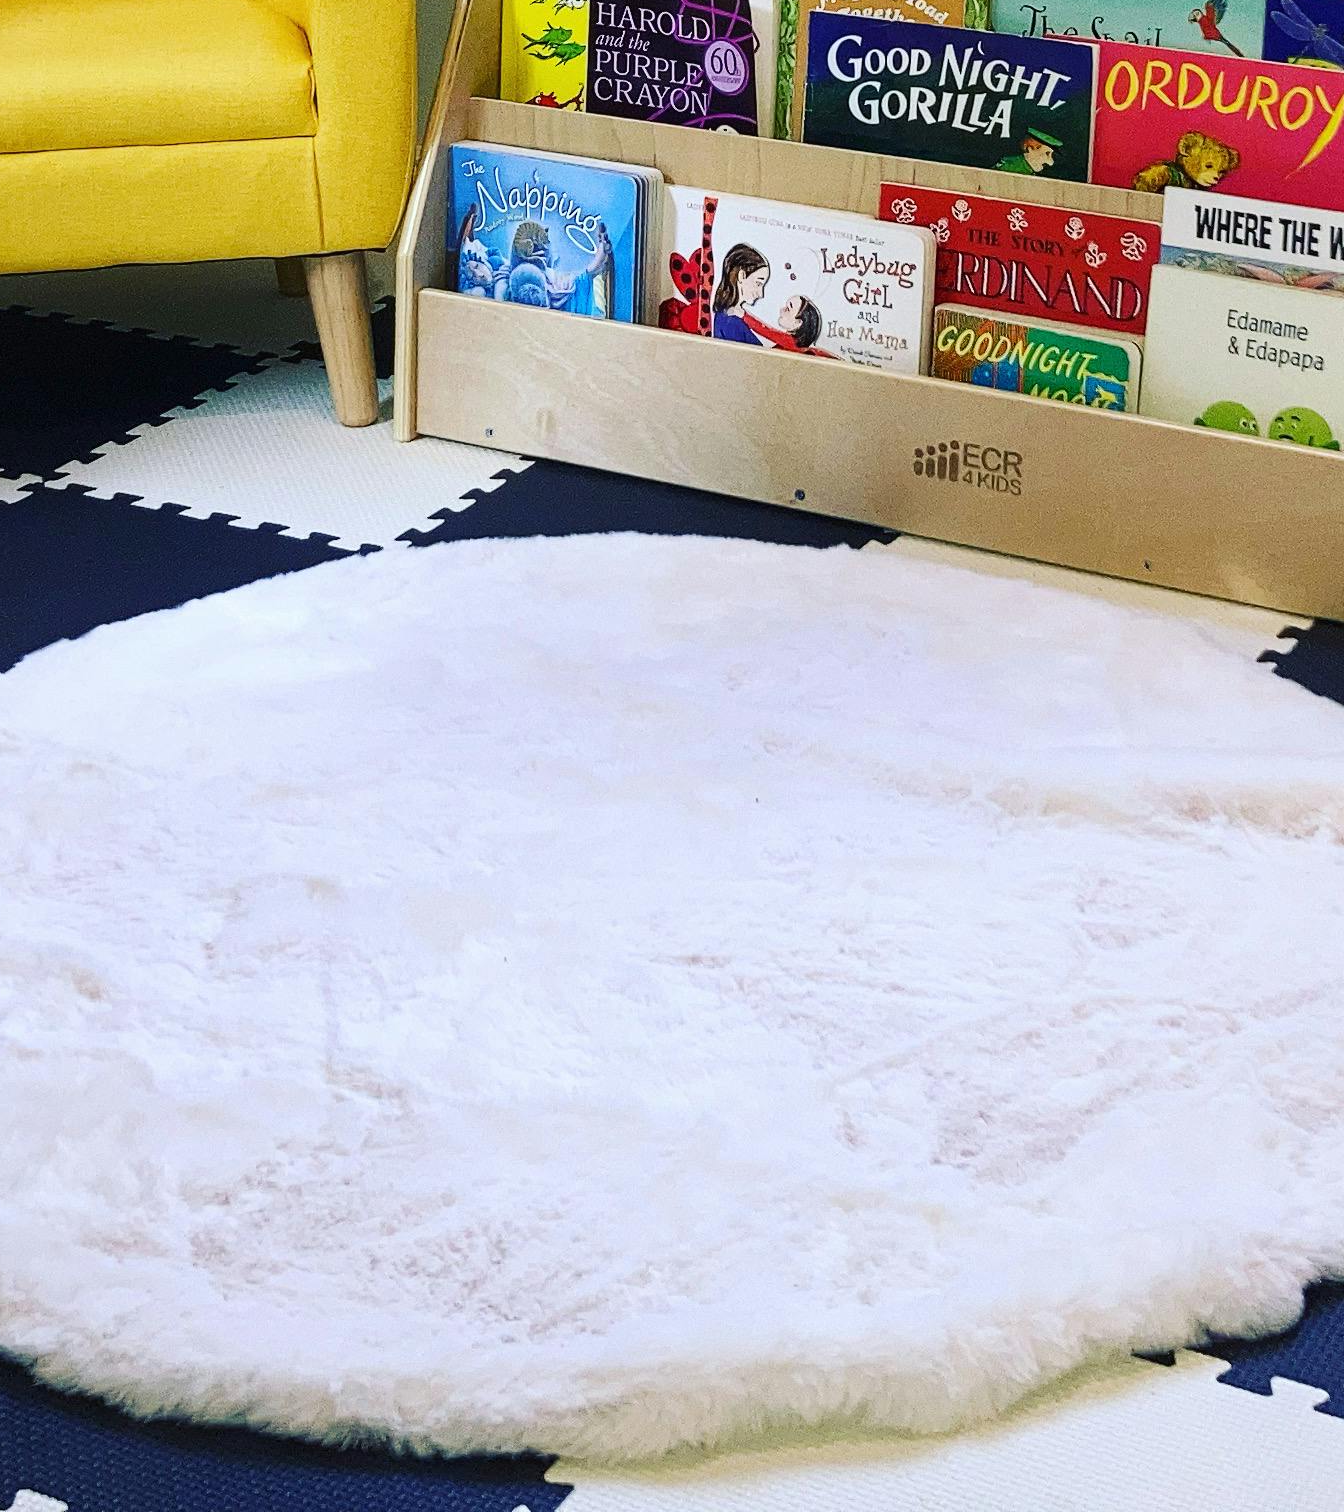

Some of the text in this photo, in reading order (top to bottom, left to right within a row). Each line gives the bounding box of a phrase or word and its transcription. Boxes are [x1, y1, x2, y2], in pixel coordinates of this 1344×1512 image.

[597, 1, 711, 42] HAROLD
[595, 31, 650, 53] and the
[595, 48, 704, 89] PURPLE
[593, 76, 709, 117] CRAYON
[461, 160, 485, 177] The
[474, 166, 603, 255] Napping
[967, 228, 1001, 247] THE
[1011, 235, 1067, 258] STORY
[1194, 204, 1273, 249] WHERE
[1278, 218, 1320, 258] THE
[820, 245, 917, 289] Ladybug
[937, 249, 1144, 321] ERDINAND
[827, 320, 909, 351] Her Mama
[857, 310, 880, 324] and
[1227, 308, 1310, 343] Edamame
[937, 325, 1098, 380] GOODNIGHT
[1227, 335, 1326, 374] & Edapapa
[962, 442, 1024, 479] ECR
